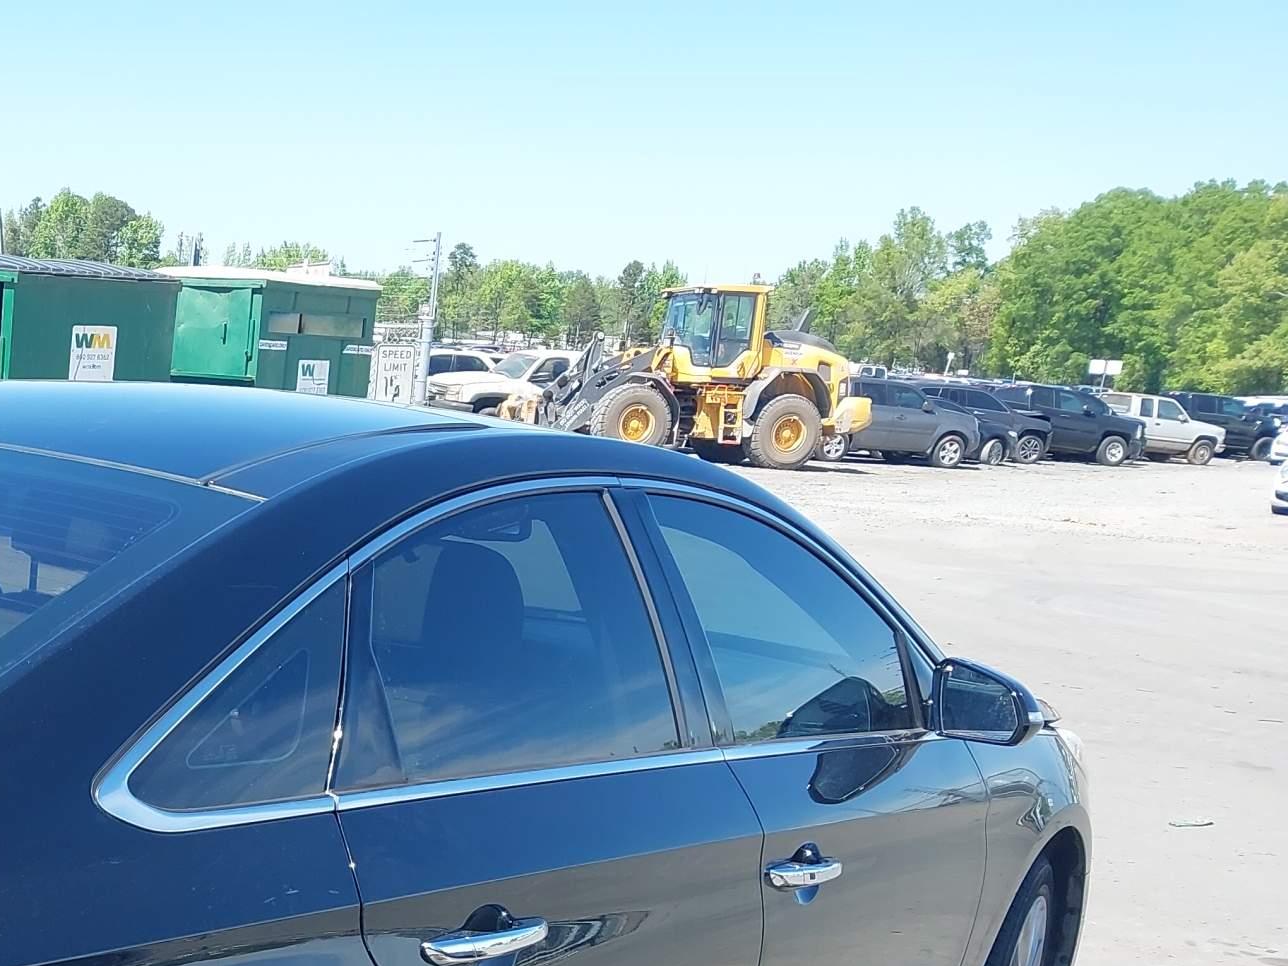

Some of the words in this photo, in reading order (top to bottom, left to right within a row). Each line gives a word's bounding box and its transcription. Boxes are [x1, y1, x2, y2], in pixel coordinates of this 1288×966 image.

[75, 333, 111, 349] WM
[381, 349, 412, 359] SPEED
[383, 362, 408, 372] LIMIT
